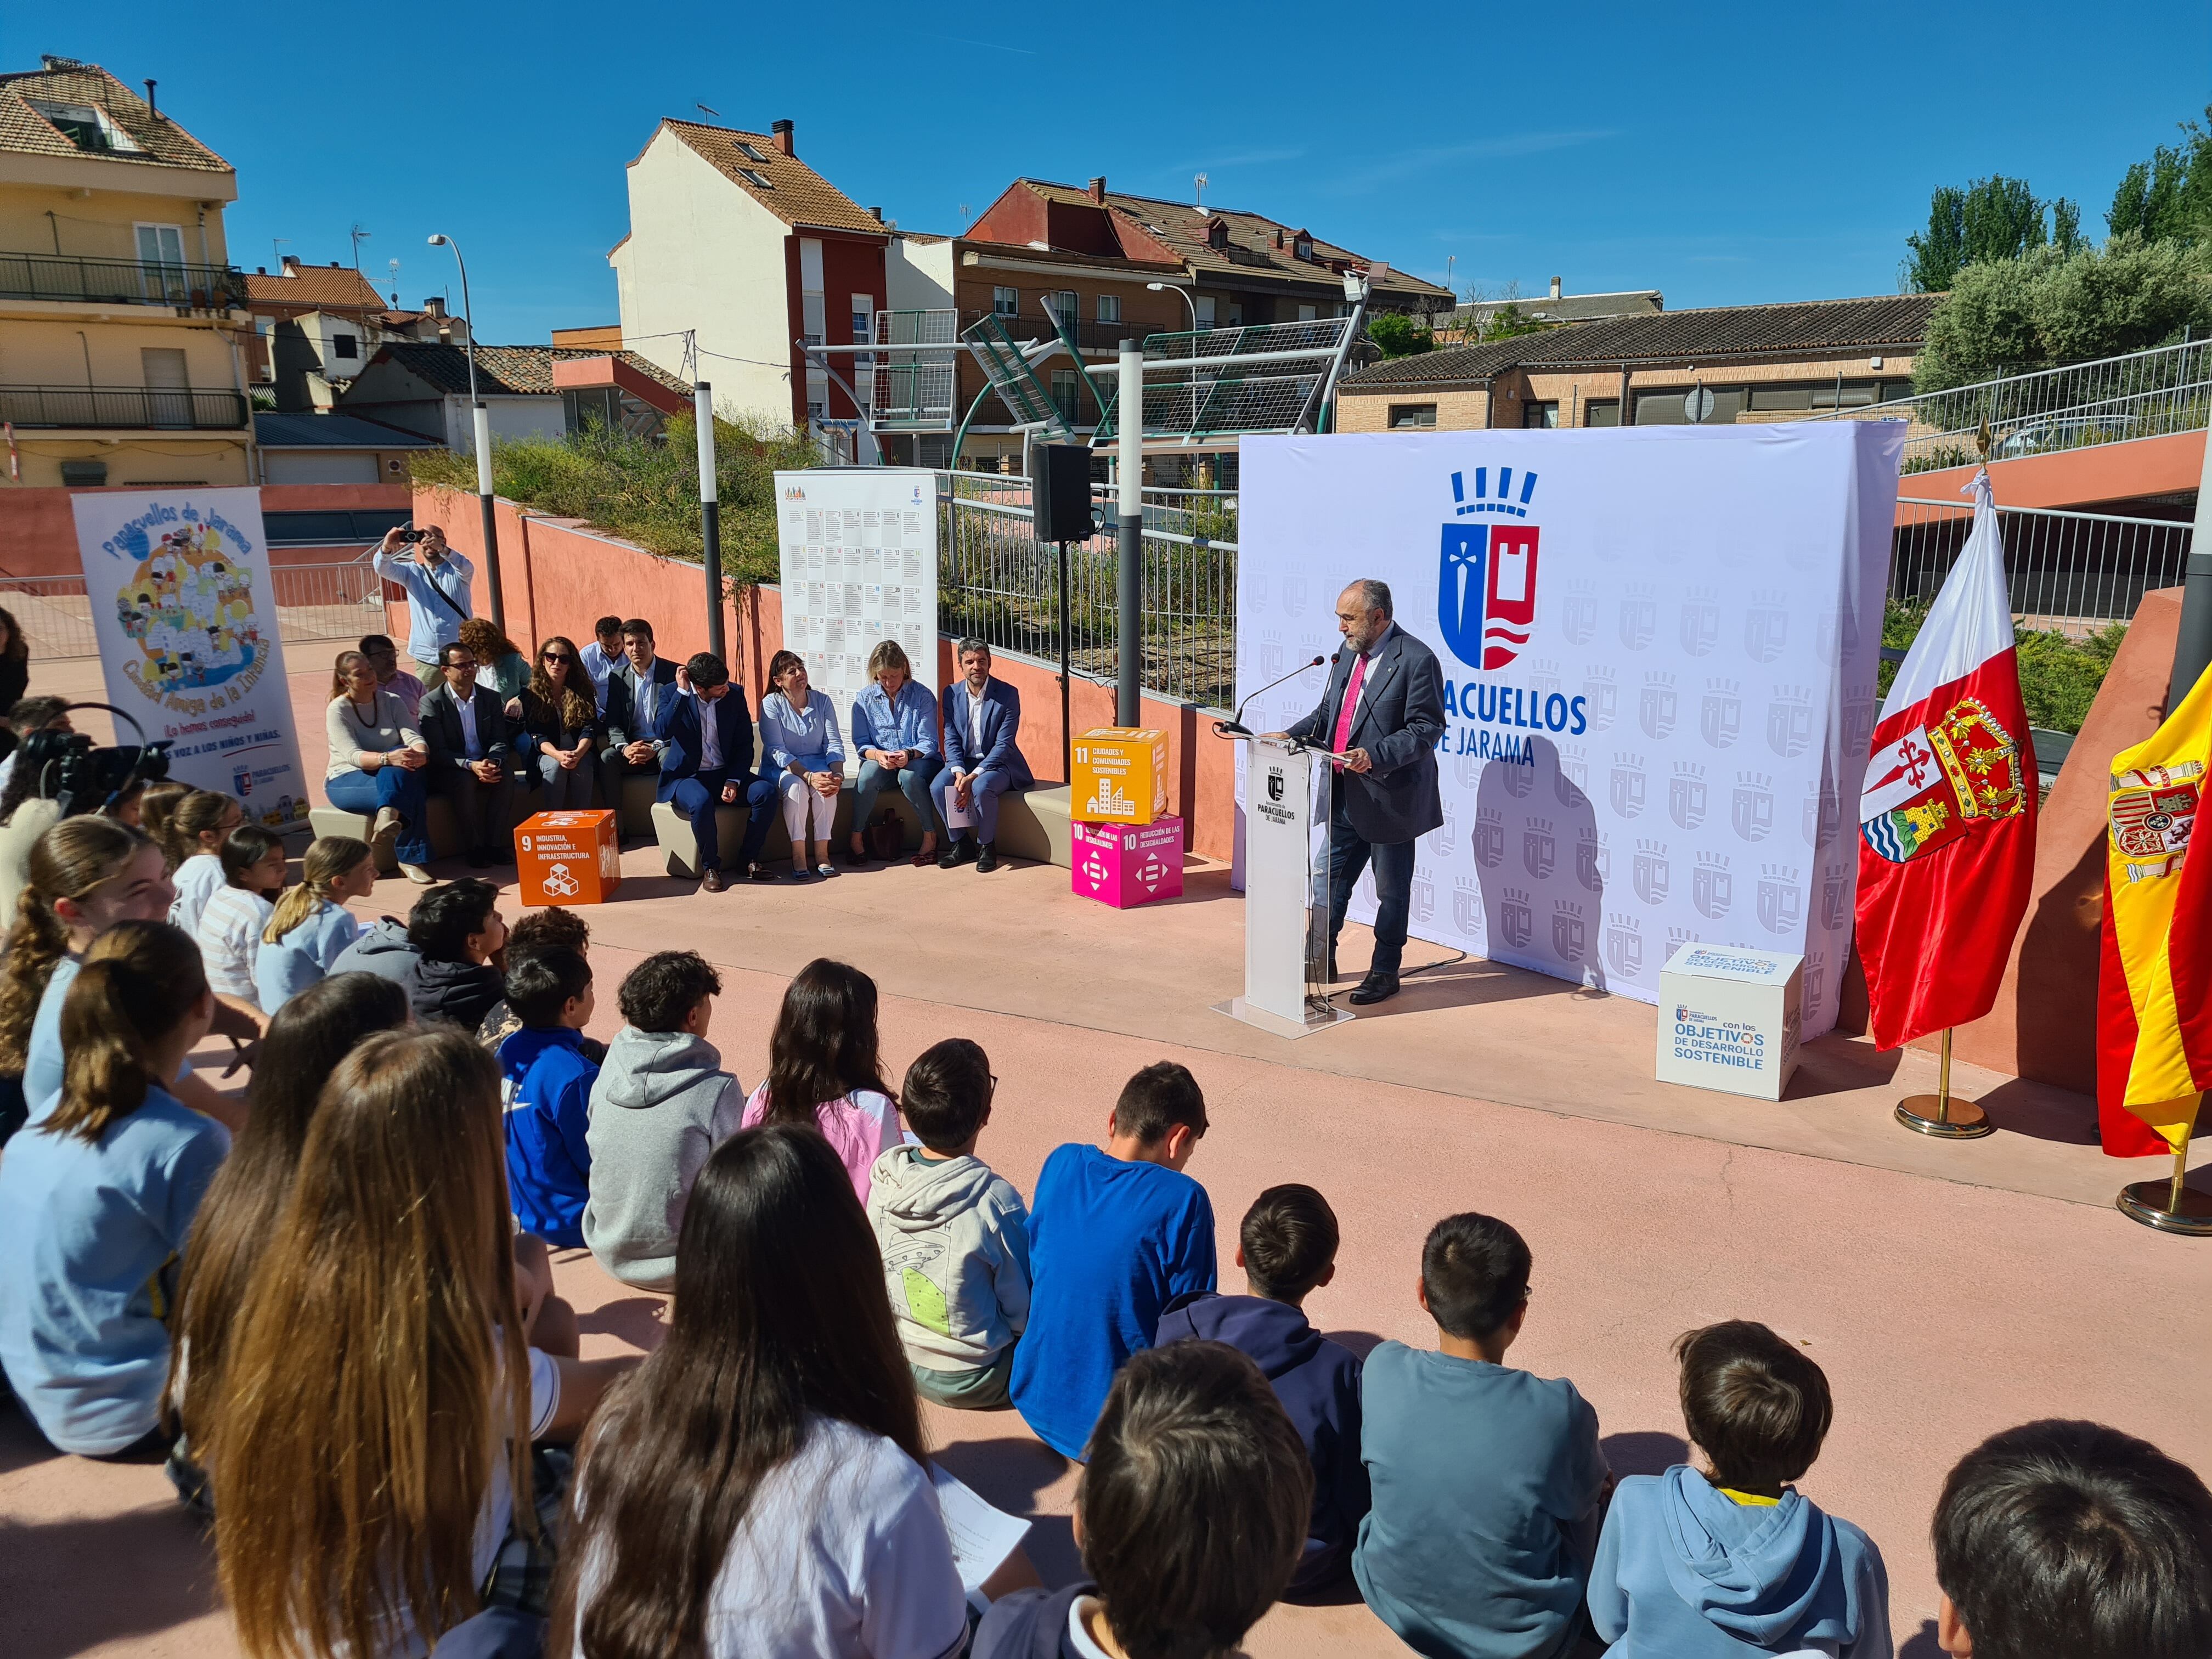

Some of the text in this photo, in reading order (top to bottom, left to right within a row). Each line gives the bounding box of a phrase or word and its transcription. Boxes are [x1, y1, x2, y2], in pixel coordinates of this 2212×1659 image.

[182, 501, 199, 522] de
[204, 507, 252, 555] Jarama
[122, 659, 165, 704] Ciudad
[165, 691, 206, 717] Amiga
[210, 692, 225, 710] de
[224, 686, 241, 703] la
[1444, 680, 1587, 735] ACUELLOS
[179, 721, 207, 735] hemos
[174, 748, 194, 759] VOZ
[194, 745, 200, 754] A
[201, 742, 217, 753] LOS
[219, 736, 245, 749] NIÑOS
[247, 735, 252, 743] Y
[254, 729, 281, 742] NIÑAS.
[1434, 724, 1534, 767] E JARAMA
[1075, 747, 1088, 764] 11
[1093, 757, 1131, 765] COMUNIDADES
[1092, 767, 1126, 775] SOSTENIBLES
[2158, 768, 2170, 785] PLVS
[1257, 804, 1295, 820] PARACUELLOS
[1271, 816, 1286, 825] JARAMA
[1073, 823, 1083, 840] 10
[1140, 827, 1165, 839] REDUCCIÓN
[522, 836, 532, 851] 9
[537, 842, 571, 851] INNOVACIÓN
[1124, 834, 1136, 851] 10
[1140, 836, 1175, 848] DESIGUALDADES
[538, 852, 590, 860] INFRAESTRUCTURA
[1684, 961, 1774, 975] SOSTENIBLE
[1690, 954, 1778, 968] OBJETIVOS
[1703, 960, 1775, 971] DESARROLLO
[1689, 1013, 1717, 1022] PARACUELLOS
[1675, 1023, 1764, 1046] OBJETIVOS
[1742, 1023, 1756, 1031] los
[1675, 1037, 1763, 1057] DE DESARROLLO
[1674, 1047, 1763, 1070] SOSTENIBLE
